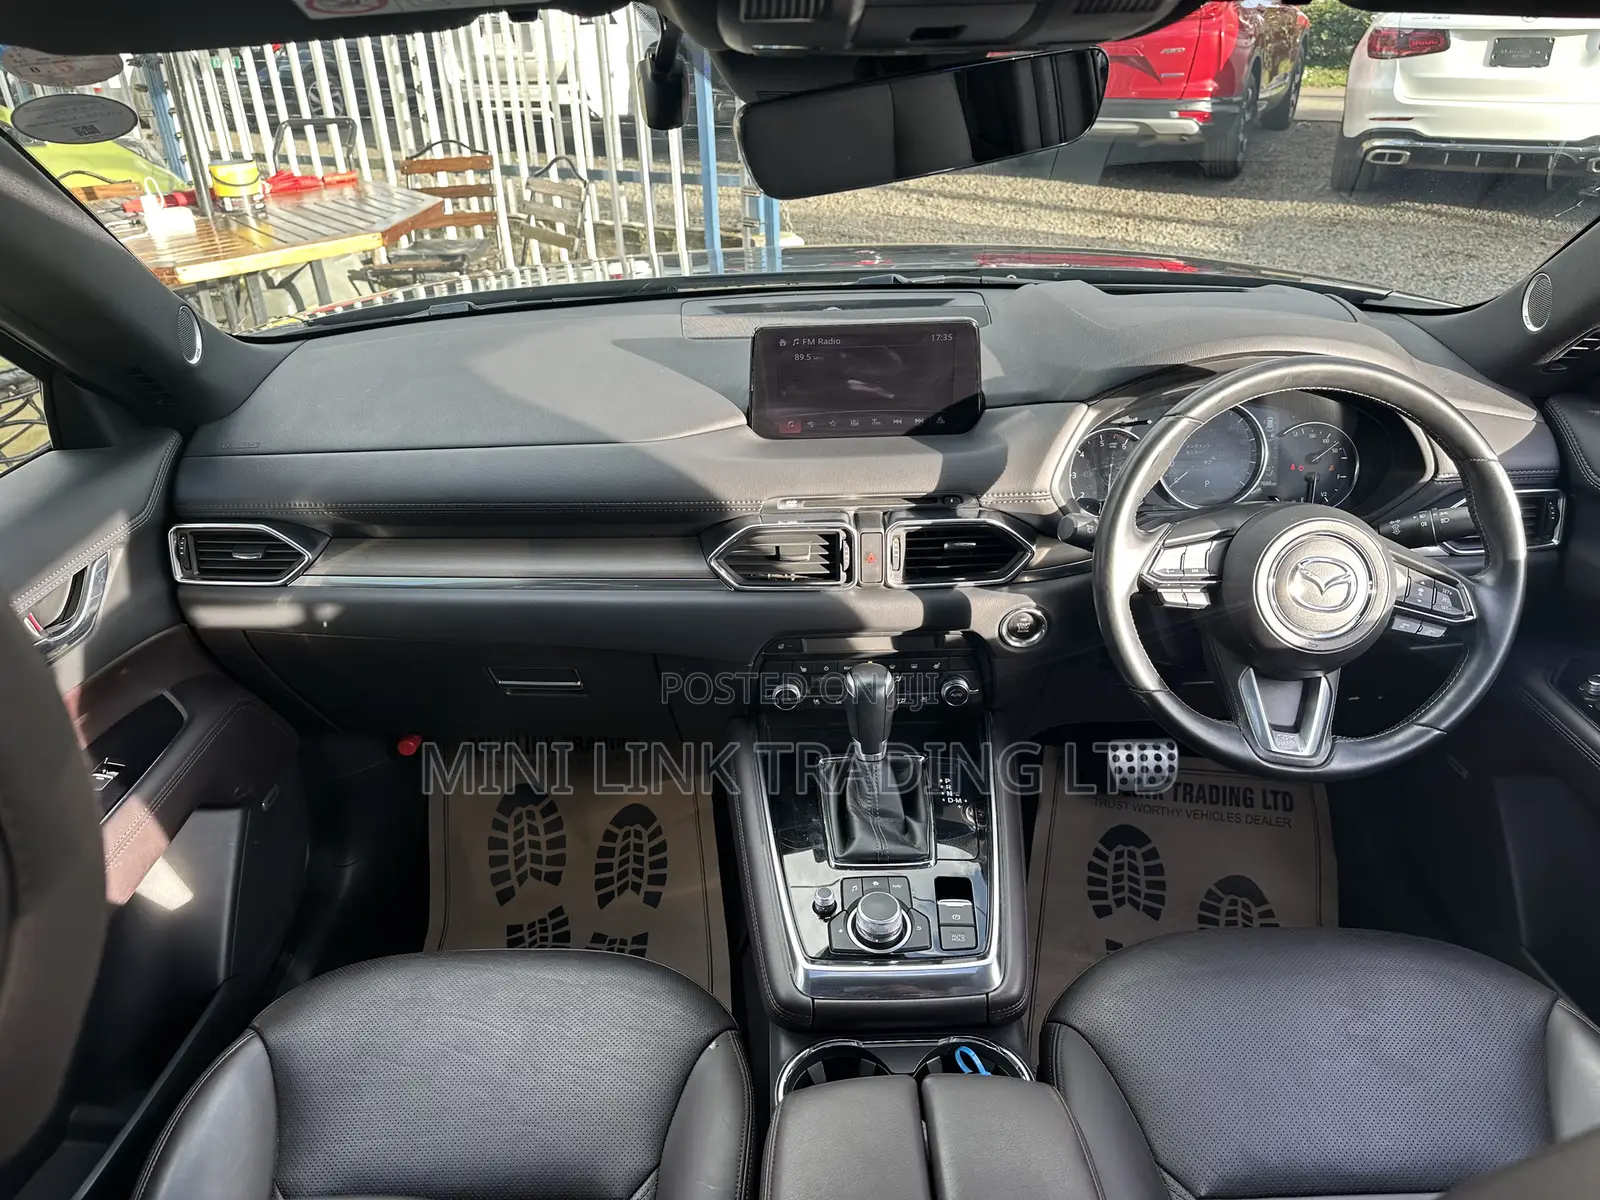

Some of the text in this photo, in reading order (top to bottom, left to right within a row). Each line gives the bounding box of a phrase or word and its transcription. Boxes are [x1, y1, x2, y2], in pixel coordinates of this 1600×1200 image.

[802, 336, 841, 346] FM Radio
[931, 333, 953, 342] 17:35
[794, 353, 812, 361] 89.5
[1171, 781, 1259, 809] TRADING
[1262, 788, 1294, 812] LTD
[1093, 796, 1293, 829] TRUST WORTHY VEHICLES DEALER
